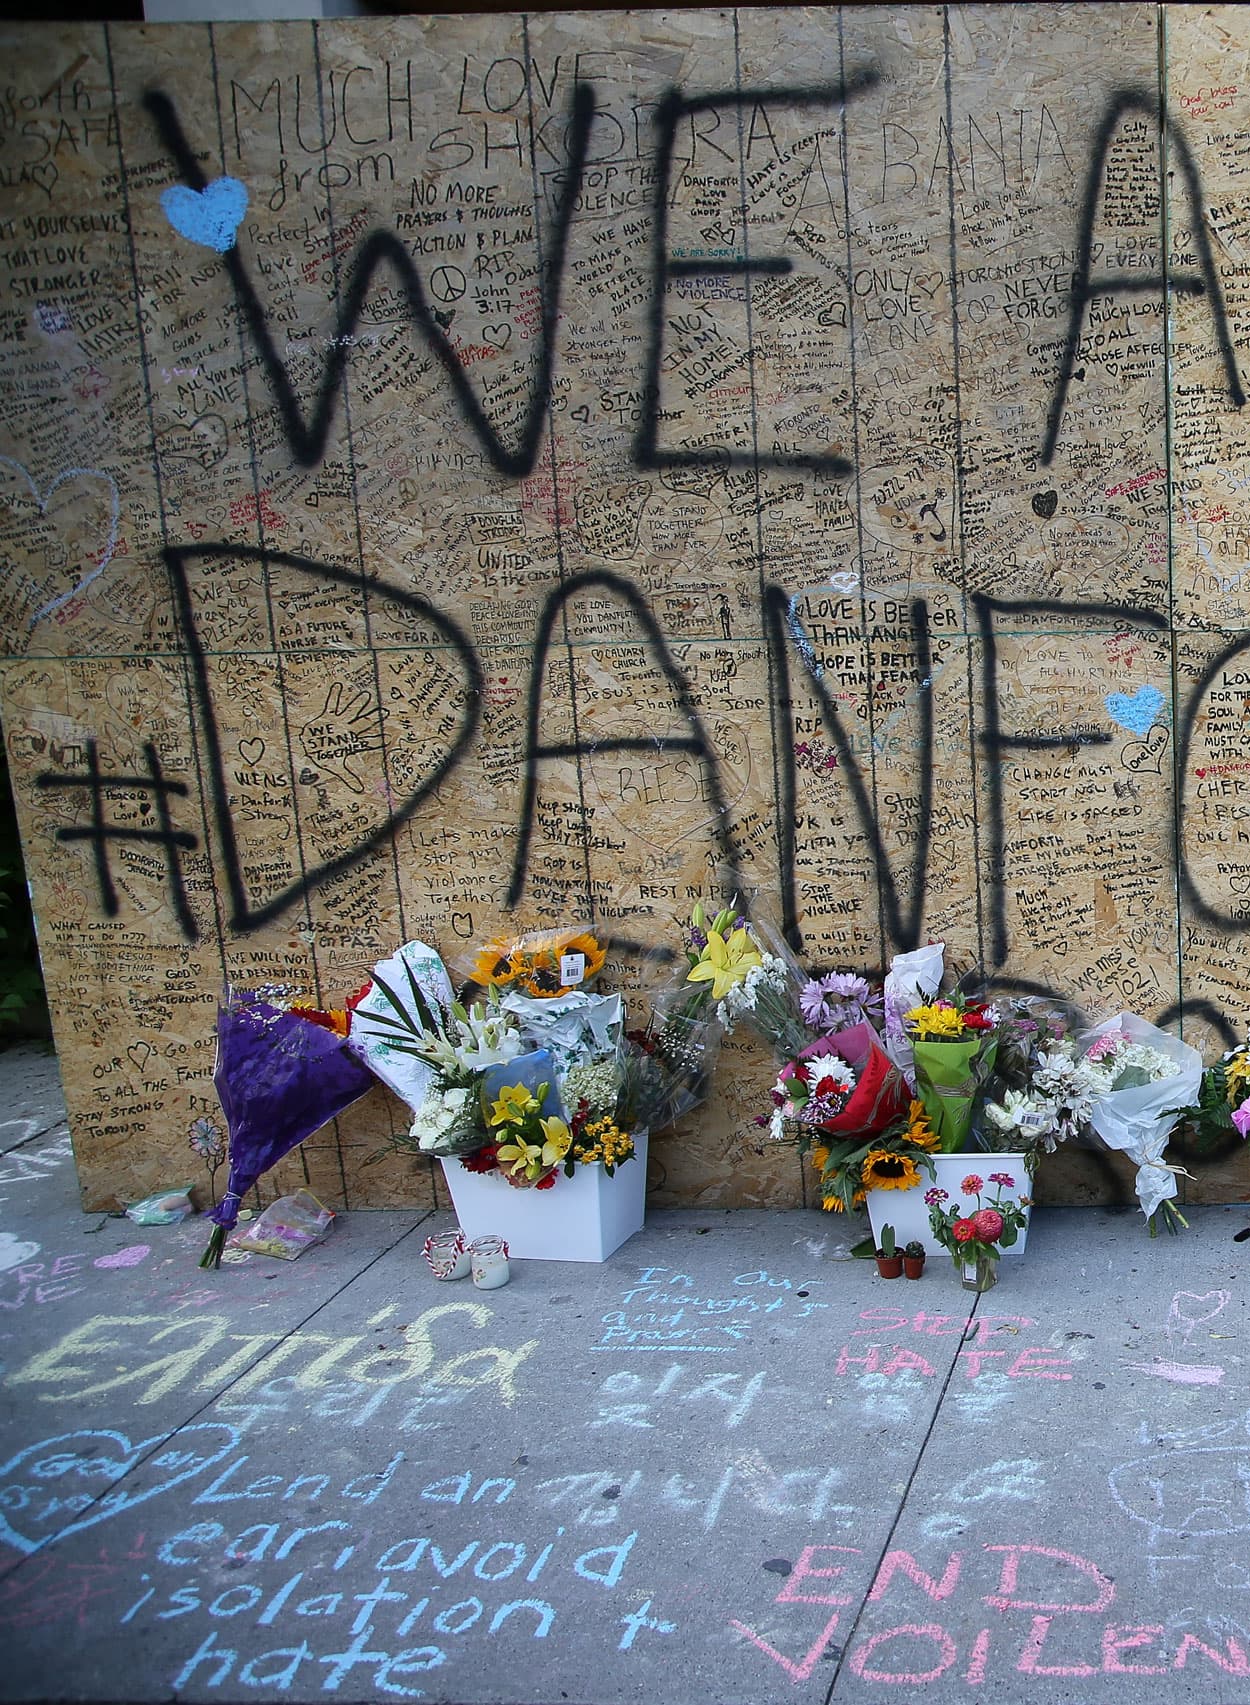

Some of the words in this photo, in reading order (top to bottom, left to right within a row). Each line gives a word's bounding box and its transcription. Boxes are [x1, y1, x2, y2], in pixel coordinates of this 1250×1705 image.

[231, 61, 414, 160] MUCH
[457, 51, 613, 116] LOVE
[269, 155, 396, 211] from
[410, 178, 437, 208] NO
[446, 182, 498, 203] MORE
[1116, 238, 1157, 249] LOVE
[140, 62, 882, 478] WE
[474, 250, 515, 278] RIP
[675, 279, 693, 288] NO
[696, 276, 730, 287] MORE
[854, 267, 912, 296] ONLY
[470, 285, 510, 299] John
[477, 300, 514, 314] 3:17
[864, 297, 921, 322] LOVE
[805, 597, 853, 620] LOVE
[307, 621, 349, 631] FUTURE
[281, 639, 318, 649] NURSE
[881, 653, 944, 665] BETTR
[837, 672, 875, 686] THAN
[881, 670, 919, 683] FEAR
[1211, 692, 1232, 702] FOR
[309, 724, 333, 736] WE
[307, 732, 358, 747] STAND
[1204, 736, 1234, 746] MUST
[1210, 748, 1242, 760] WITH
[1018, 807, 1055, 821] LIFE
[801, 884, 830, 899] STOP
[813, 893, 833, 902] THE
[804, 900, 862, 917] VIOLENCE
[50, 921, 81, 931] WHAT
[88, 922, 125, 930] CAUSED
[251, 953, 281, 963] WILL
[284, 954, 309, 964] NOT
[166, 969, 190, 978] GOD
[164, 982, 196, 990] BLESS
[164, 994, 213, 1003] TORONTO
[165, 1043, 187, 1057] GO
[93, 1057, 124, 1078] OUR
[116, 1085, 139, 1097] ALL
[142, 1079, 168, 1092] THE
[75, 1112, 103, 1122] STAY
[111, 1101, 164, 1118] STRONG
[87, 1123, 145, 1138] TORONTO
[835, 1347, 1073, 1381] HATE
[193, 1451, 406, 1504] Lend
[421, 1470, 517, 1505] an
[376, 1526, 638, 1588] avoid
[774, 1544, 1117, 1613] END
[120, 1572, 557, 1639] isolation
[172, 1625, 448, 1698] hate
